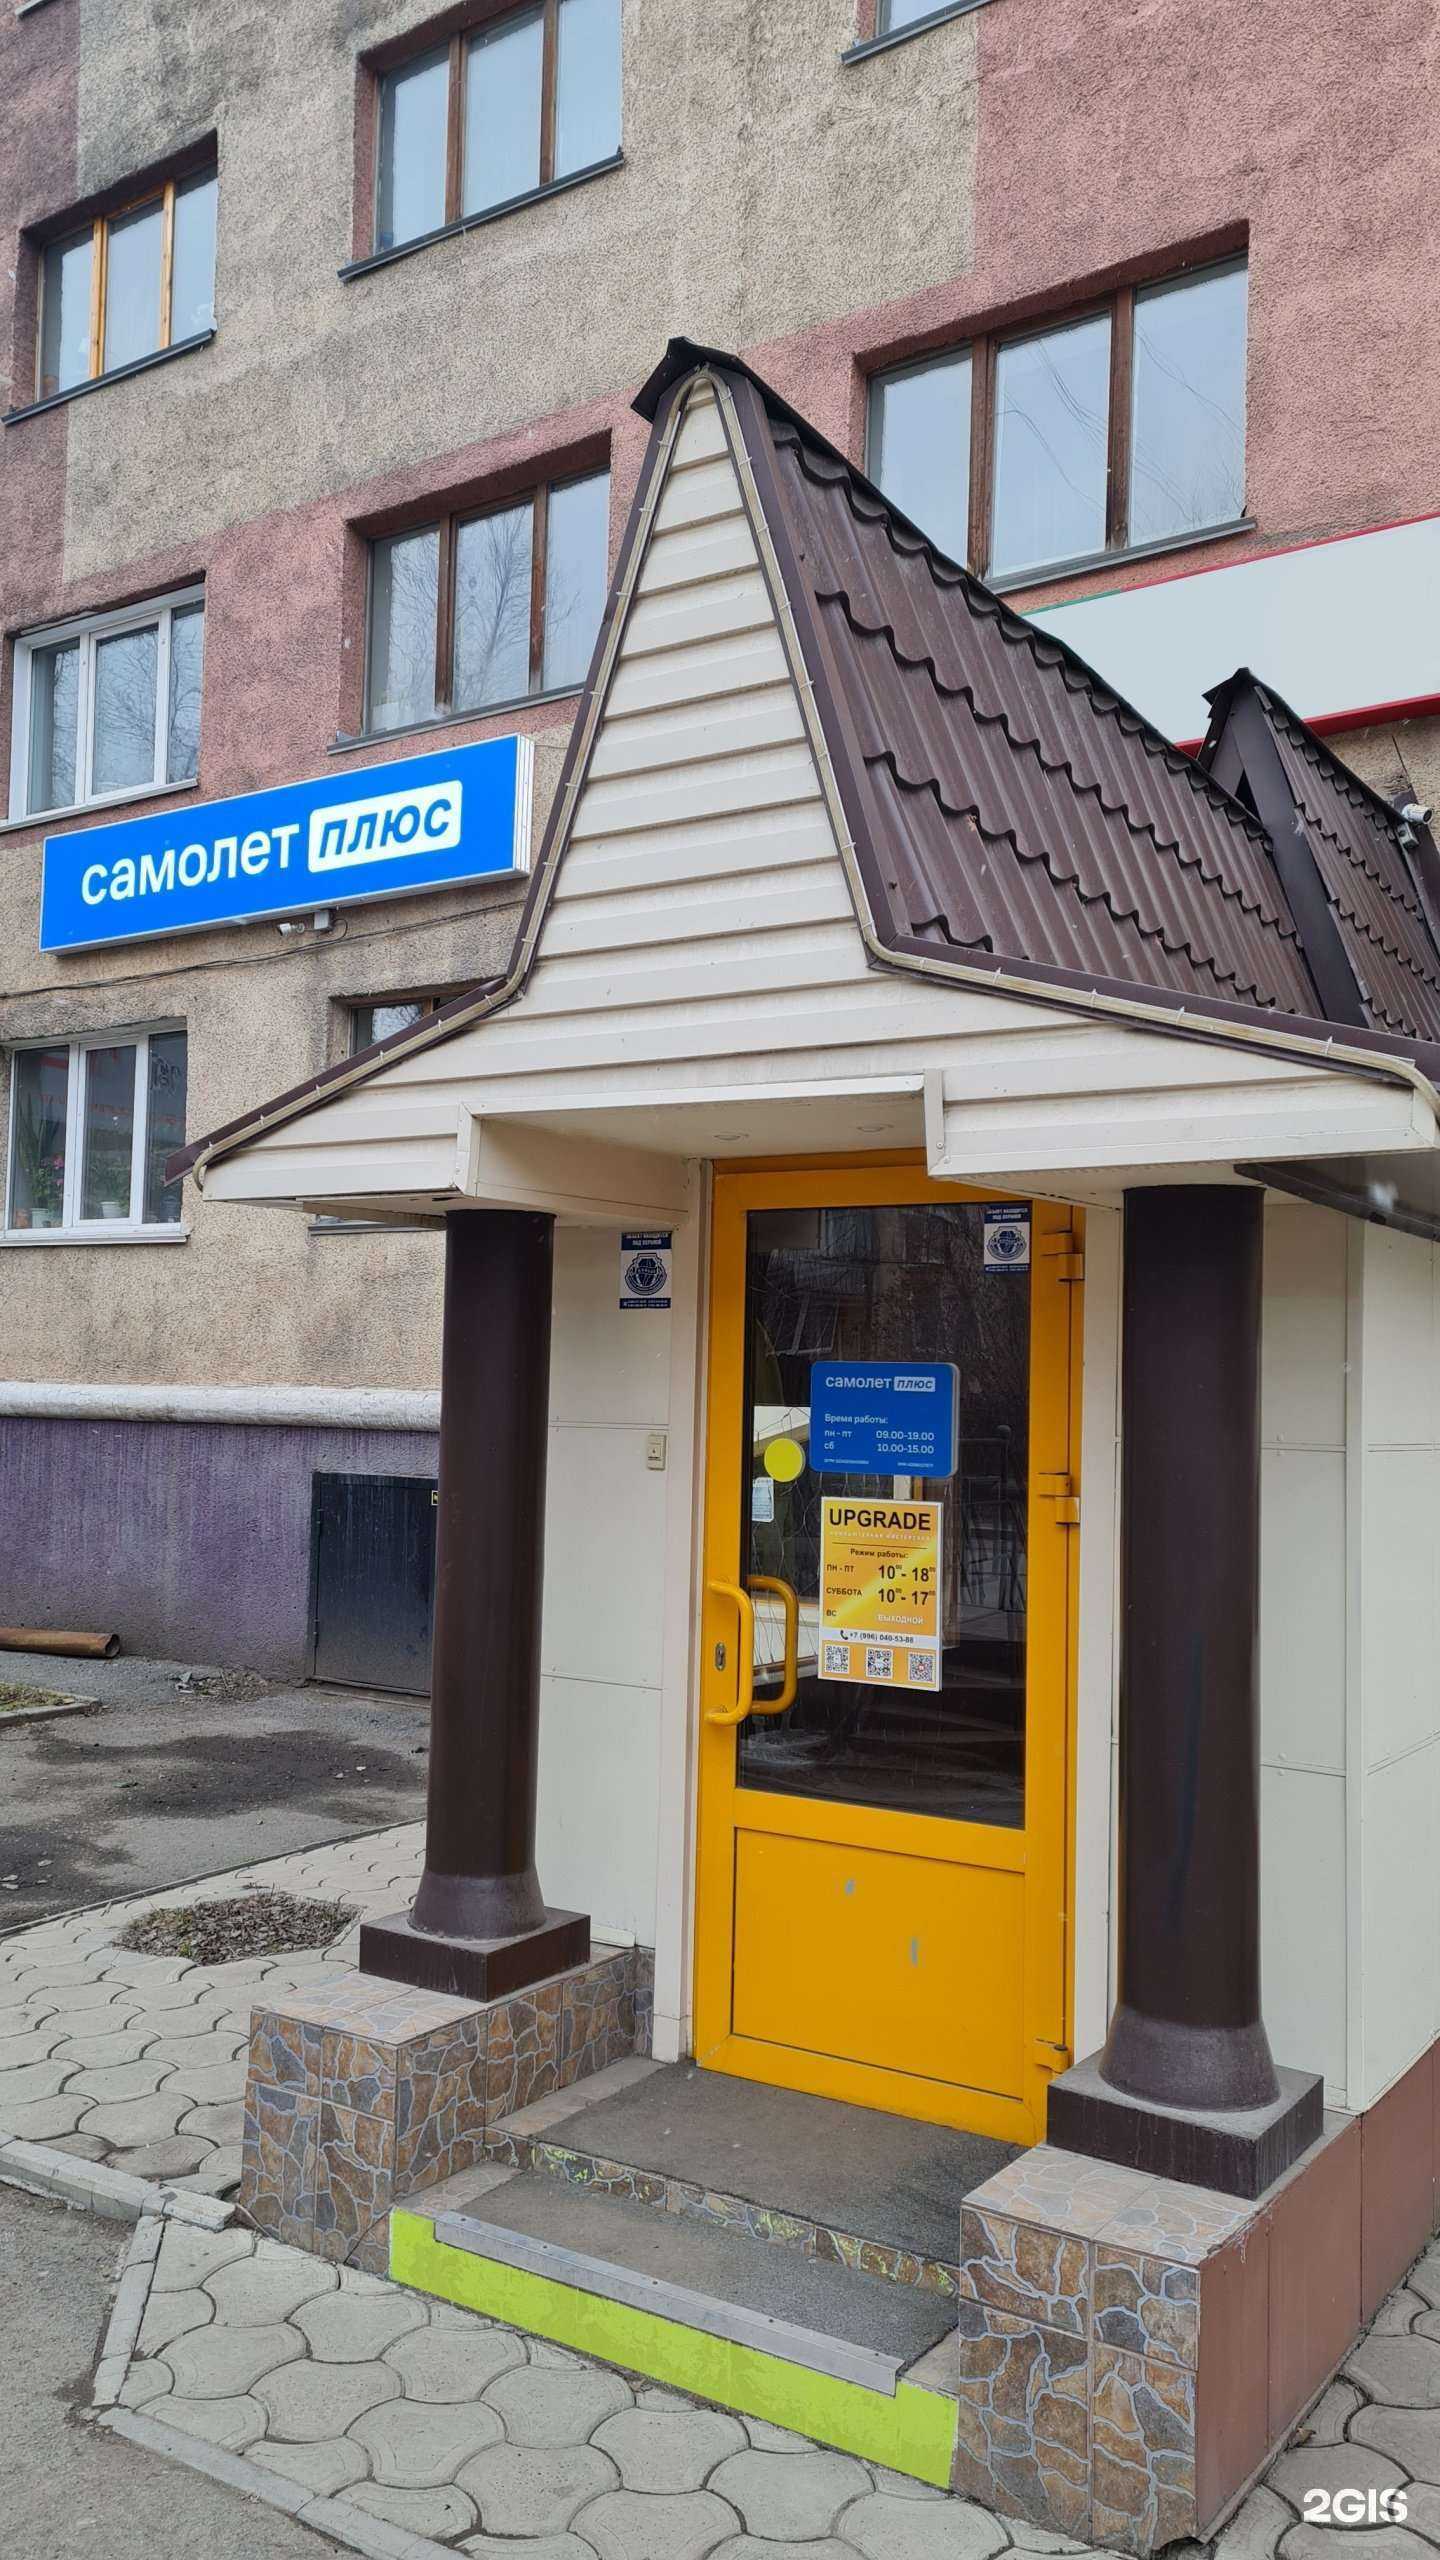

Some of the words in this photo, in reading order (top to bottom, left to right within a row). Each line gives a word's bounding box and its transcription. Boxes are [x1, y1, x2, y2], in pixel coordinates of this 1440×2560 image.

[81, 823, 299, 906] самолет
[319, 797, 453, 858] плюс
[825, 1376, 892, 1389] самолет
[896, 1379, 934, 1390] плюс
[824, 1413, 853, 1424] Время
[854, 1414, 889, 1425] работы:
[824, 1441, 835, 1450] сб
[829, 1508, 932, 1531] UPGRADE
[850, 1548, 876, 1557] Режим
[877, 1550, 909, 1560] работы:
[826, 1587, 863, 1598] СУББОТА
[826, 1609, 837, 1617] ВС
